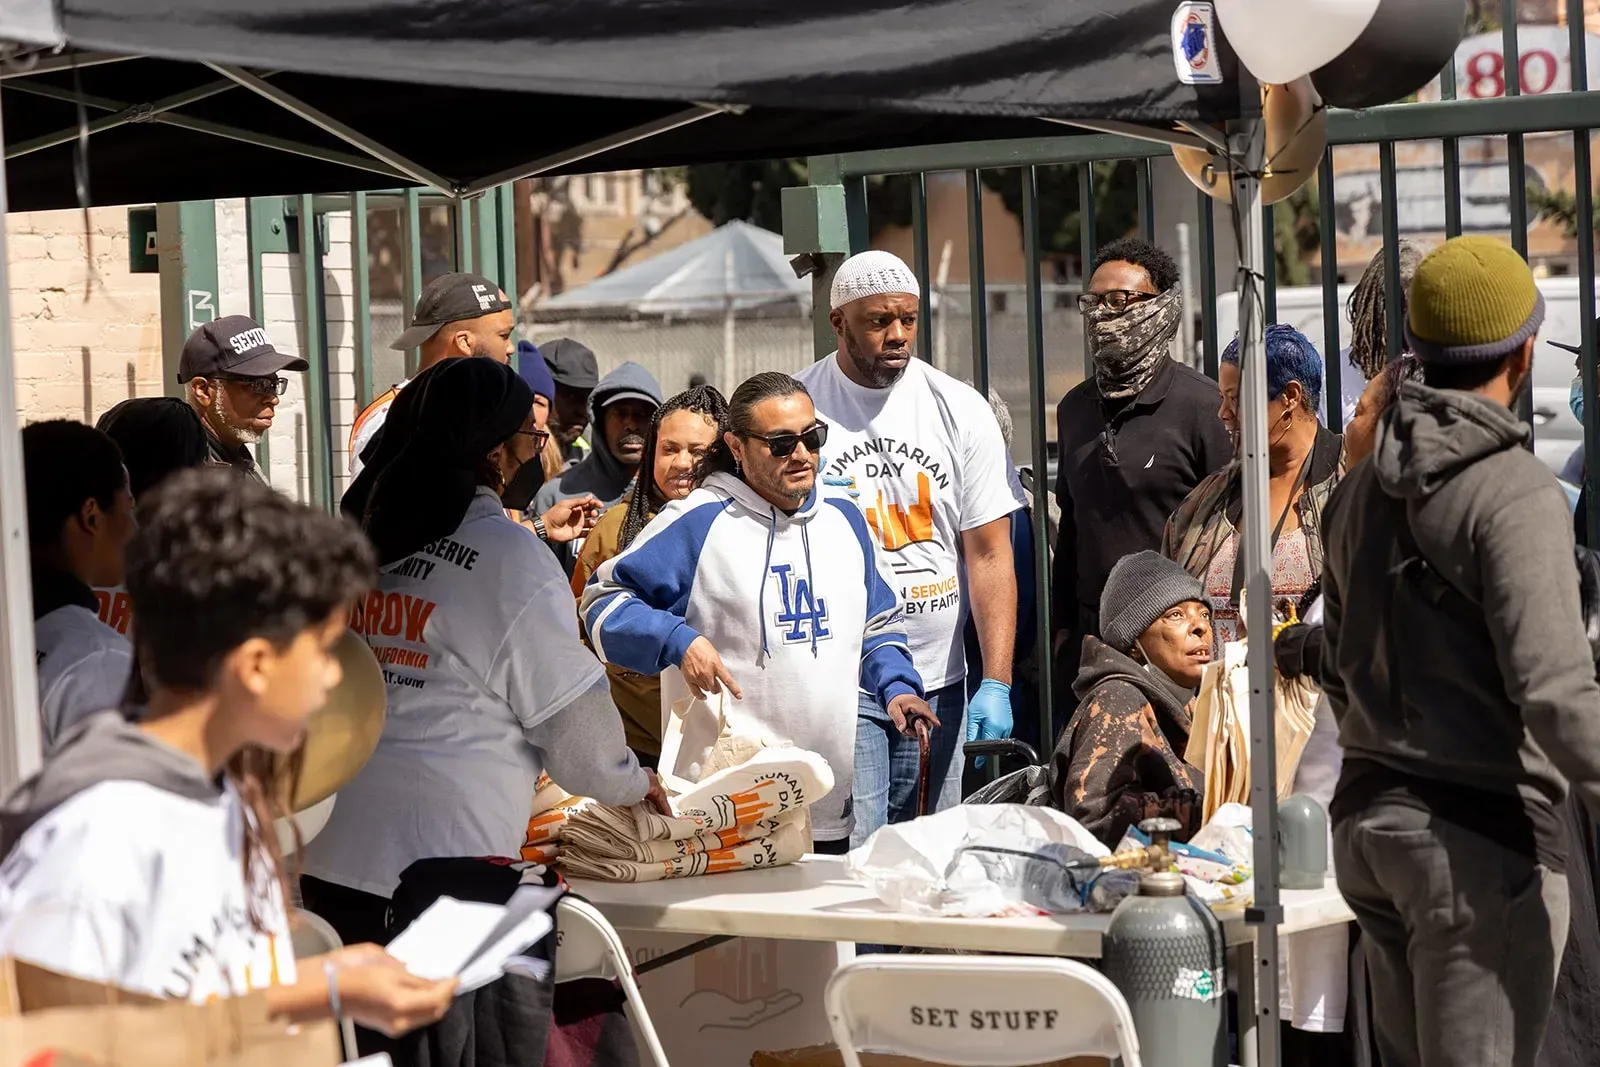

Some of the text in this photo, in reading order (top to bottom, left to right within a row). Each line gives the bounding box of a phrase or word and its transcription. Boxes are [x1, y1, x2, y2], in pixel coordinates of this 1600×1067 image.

[1466, 49, 1570, 98] 80
[229, 327, 271, 355] SECU
[826, 437, 950, 490] UMANITARIAN
[865, 462, 905, 478] DAY
[910, 575, 957, 599] SERVICE
[770, 563, 830, 641] LA
[906, 590, 960, 614] BY FAITH
[371, 646, 430, 670] ALIFORNIA
[778, 791, 789, 812] DA
[910, 1005, 1059, 1030] SET STUFF
